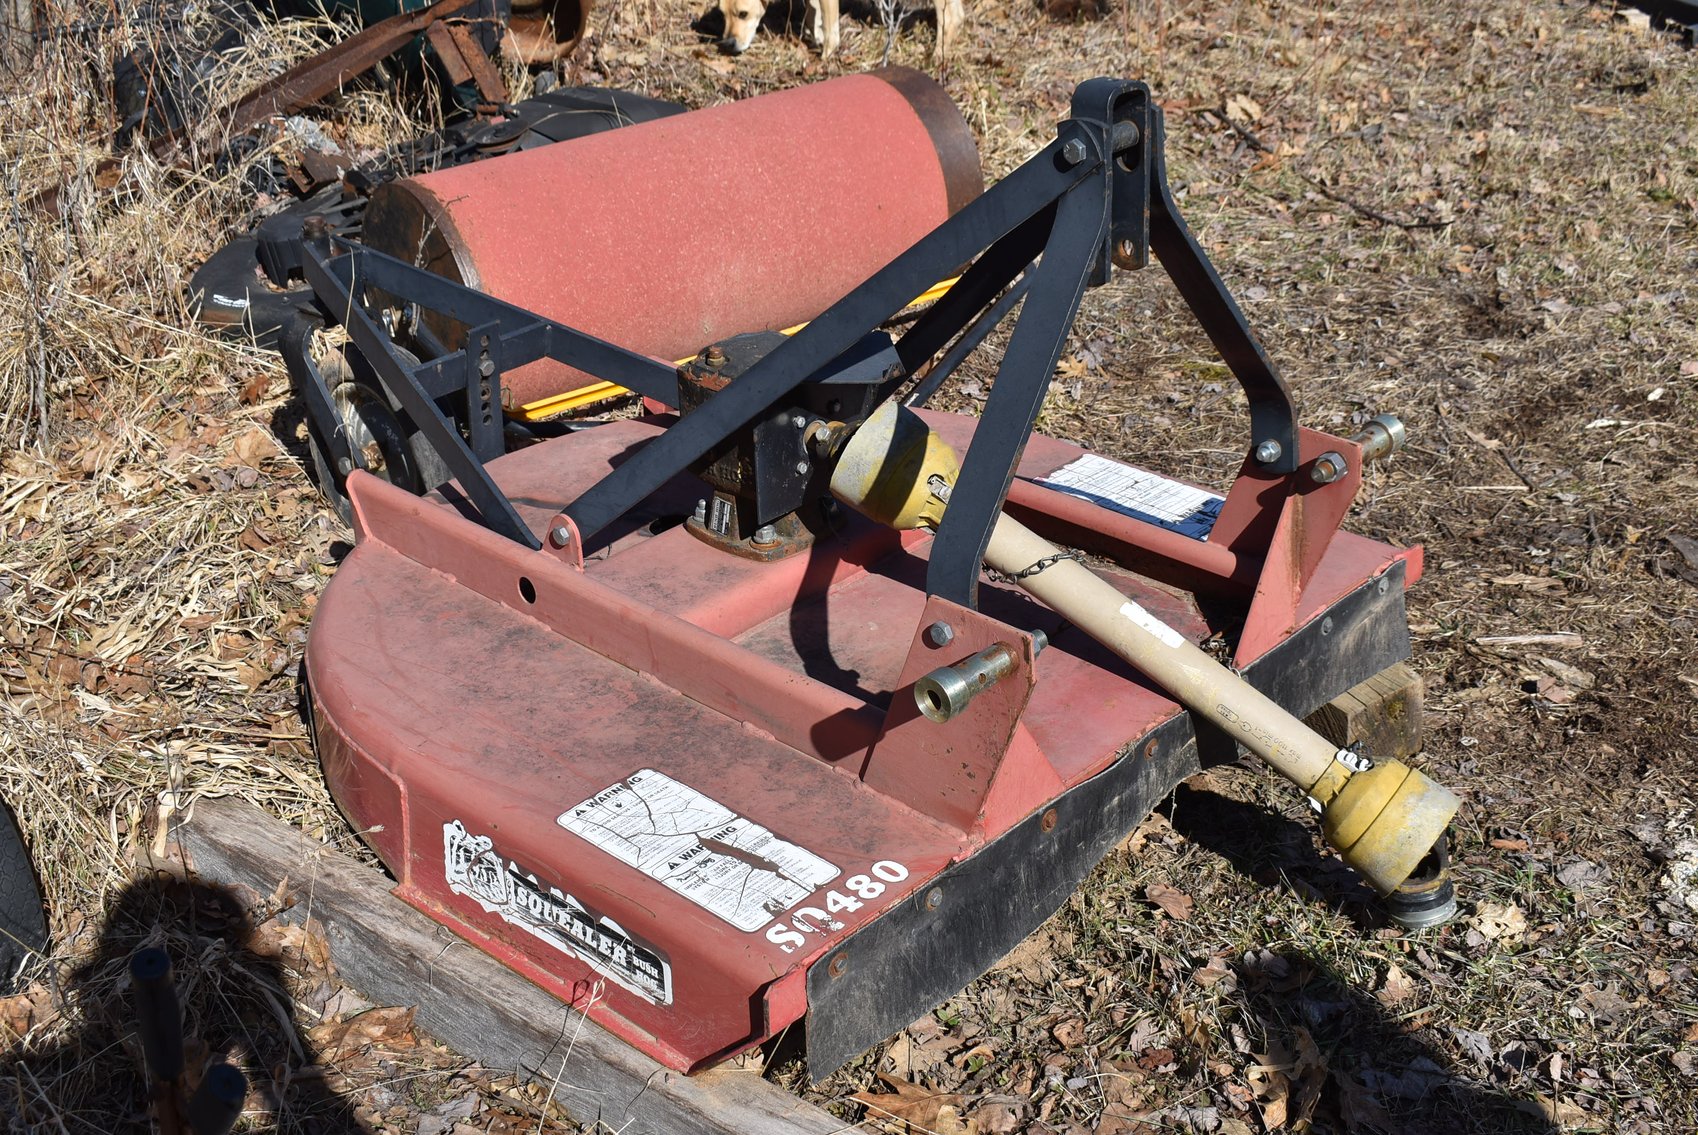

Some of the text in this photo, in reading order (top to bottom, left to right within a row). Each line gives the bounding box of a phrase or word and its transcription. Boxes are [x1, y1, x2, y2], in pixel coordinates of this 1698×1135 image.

[679, 826, 737, 861] WARING
[516, 886, 627, 967] SQUEALER
[766, 861, 909, 953] SQ480
[633, 955, 659, 978] BUSH
